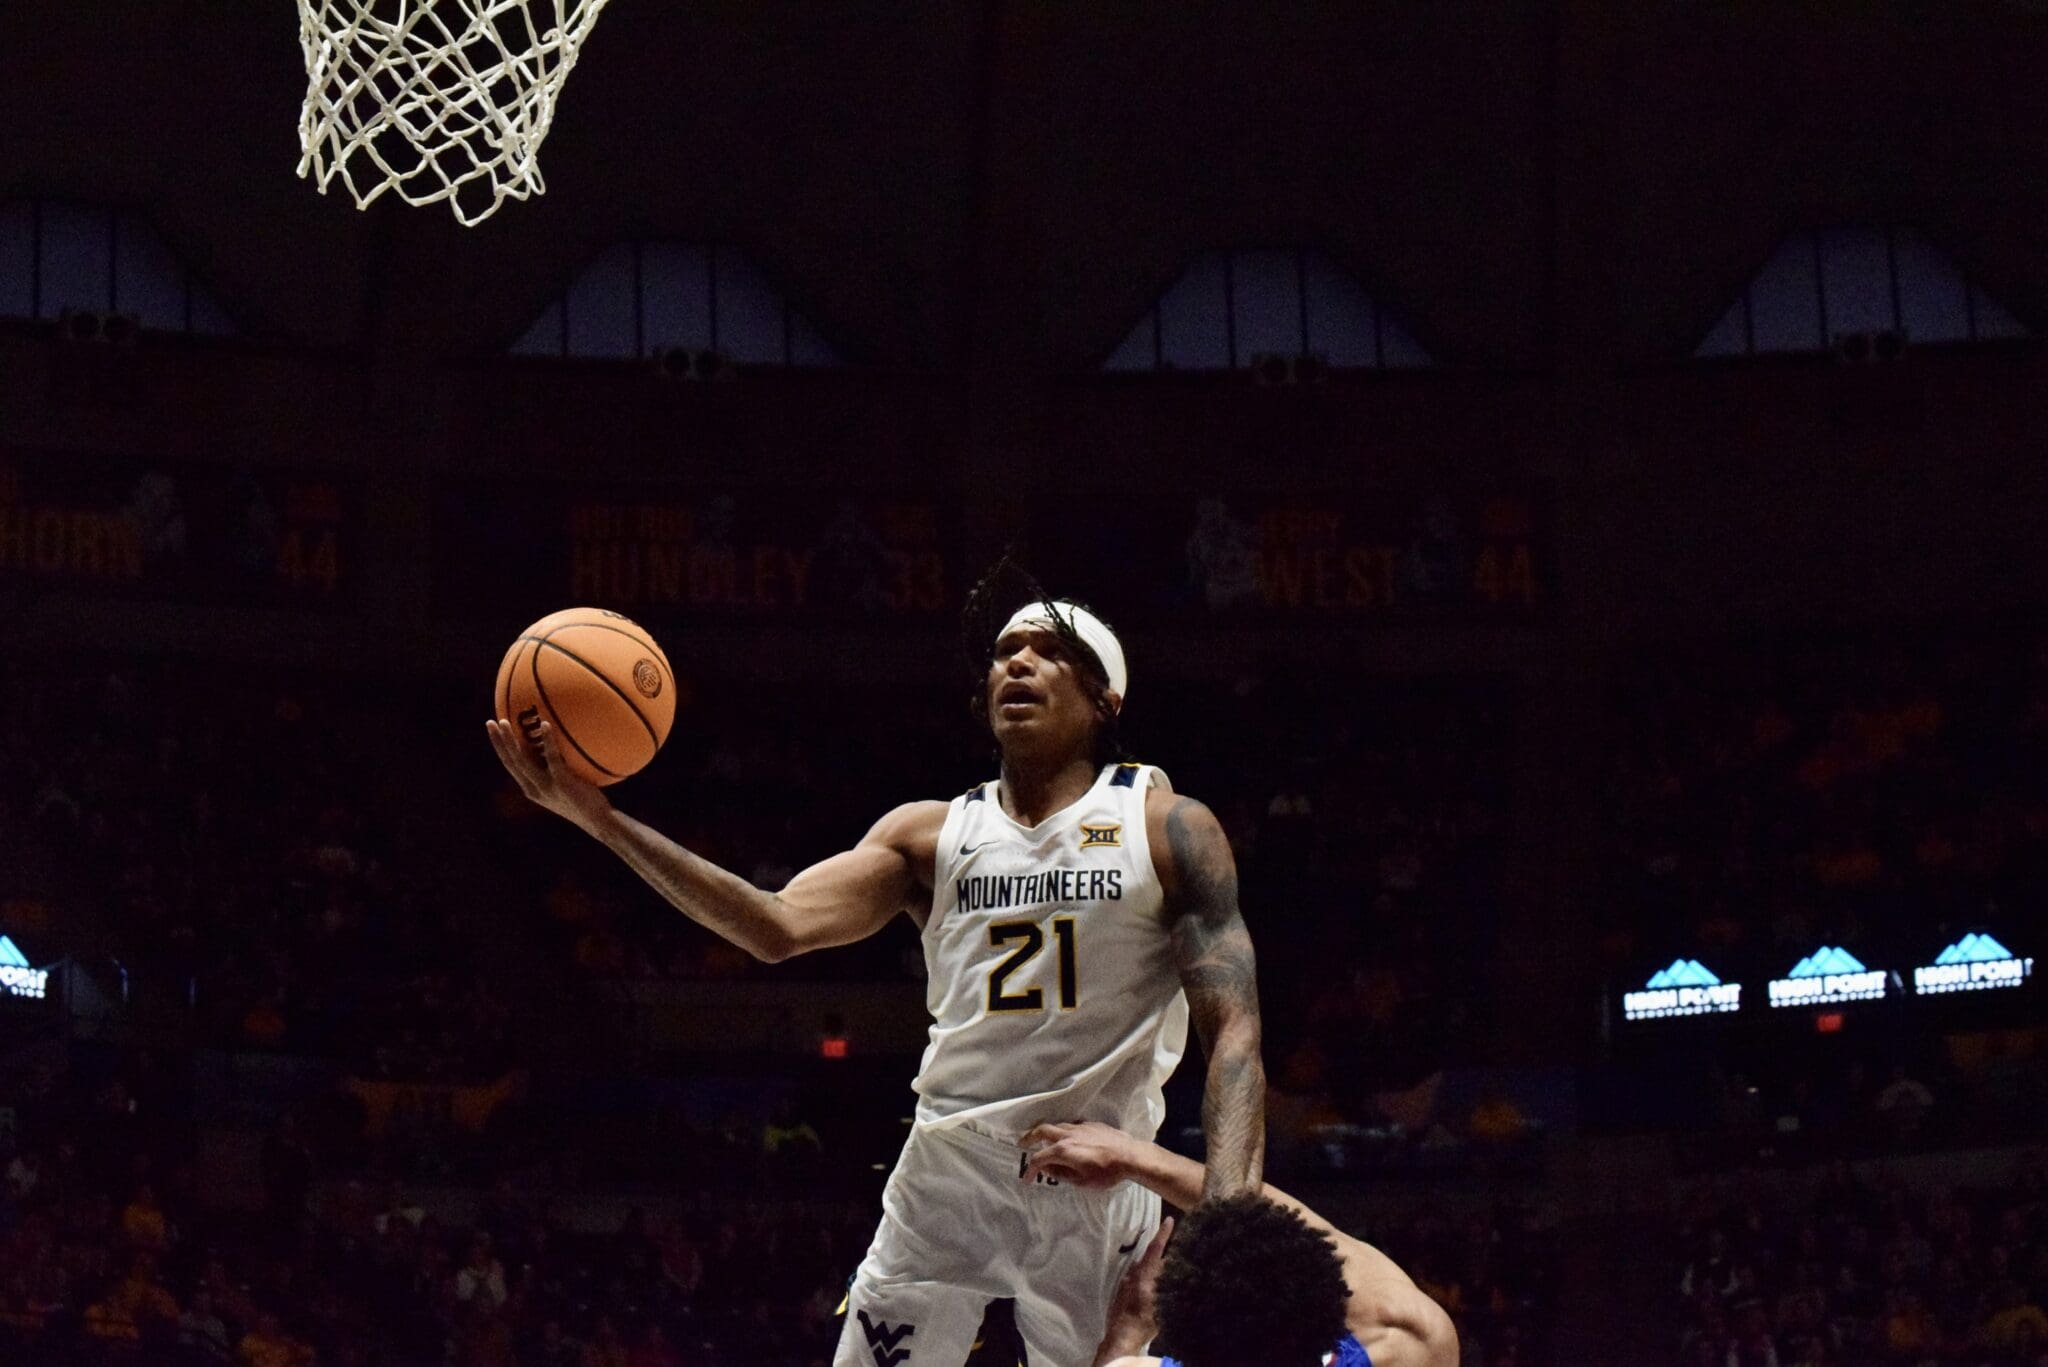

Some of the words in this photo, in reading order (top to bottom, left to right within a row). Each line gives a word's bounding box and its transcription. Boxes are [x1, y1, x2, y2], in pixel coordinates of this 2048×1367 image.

[1253, 543, 1399, 608] WEST
[957, 868, 1122, 914] MOUNTAINEERS
[986, 915, 1079, 1015] 21
